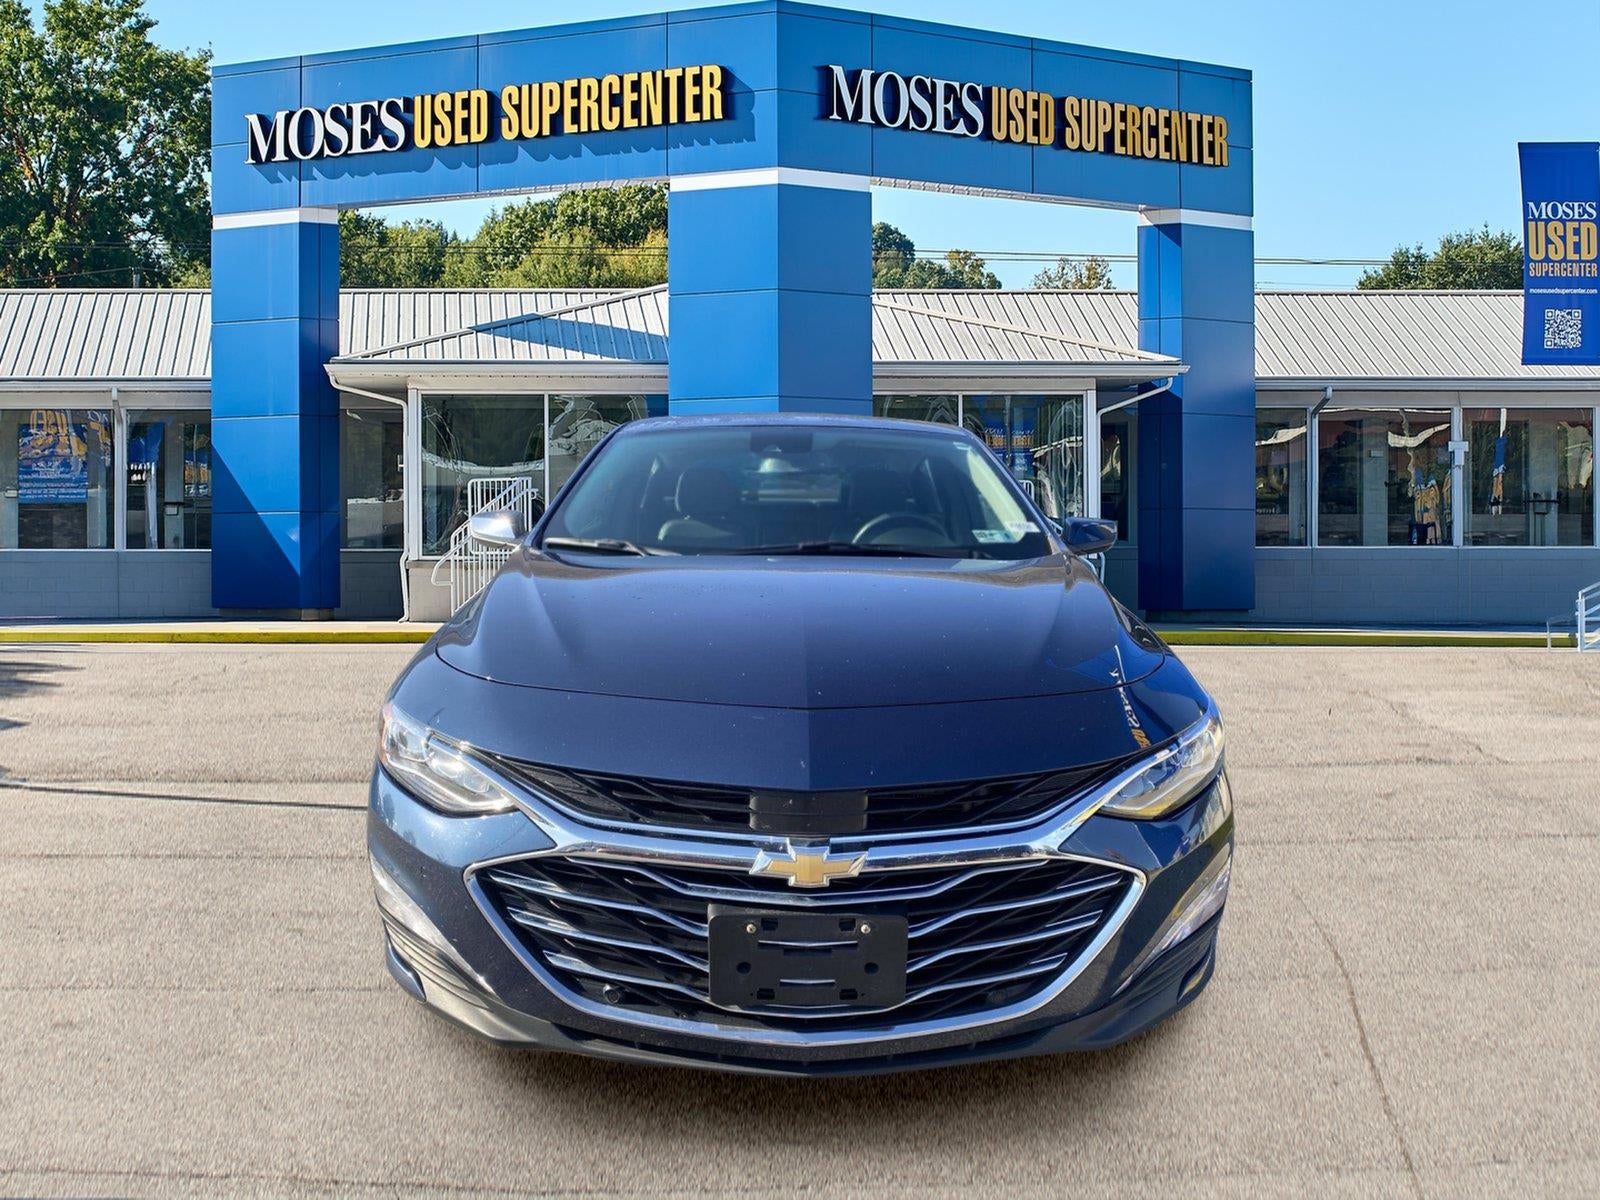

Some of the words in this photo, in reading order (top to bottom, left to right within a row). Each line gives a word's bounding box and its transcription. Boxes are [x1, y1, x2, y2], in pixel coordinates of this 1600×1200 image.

[245, 98, 407, 165] MOSES
[413, 89, 489, 148] USED
[500, 64, 725, 139] SUPERCENTER
[829, 64, 984, 138] MOSES
[991, 86, 1056, 146] USED
[1065, 95, 1230, 167] SUPERCENTER
[1527, 201, 1597, 219] MOSES
[1528, 221, 1598, 261] USED
[1529, 262, 1598, 277] SUPERCENTER
